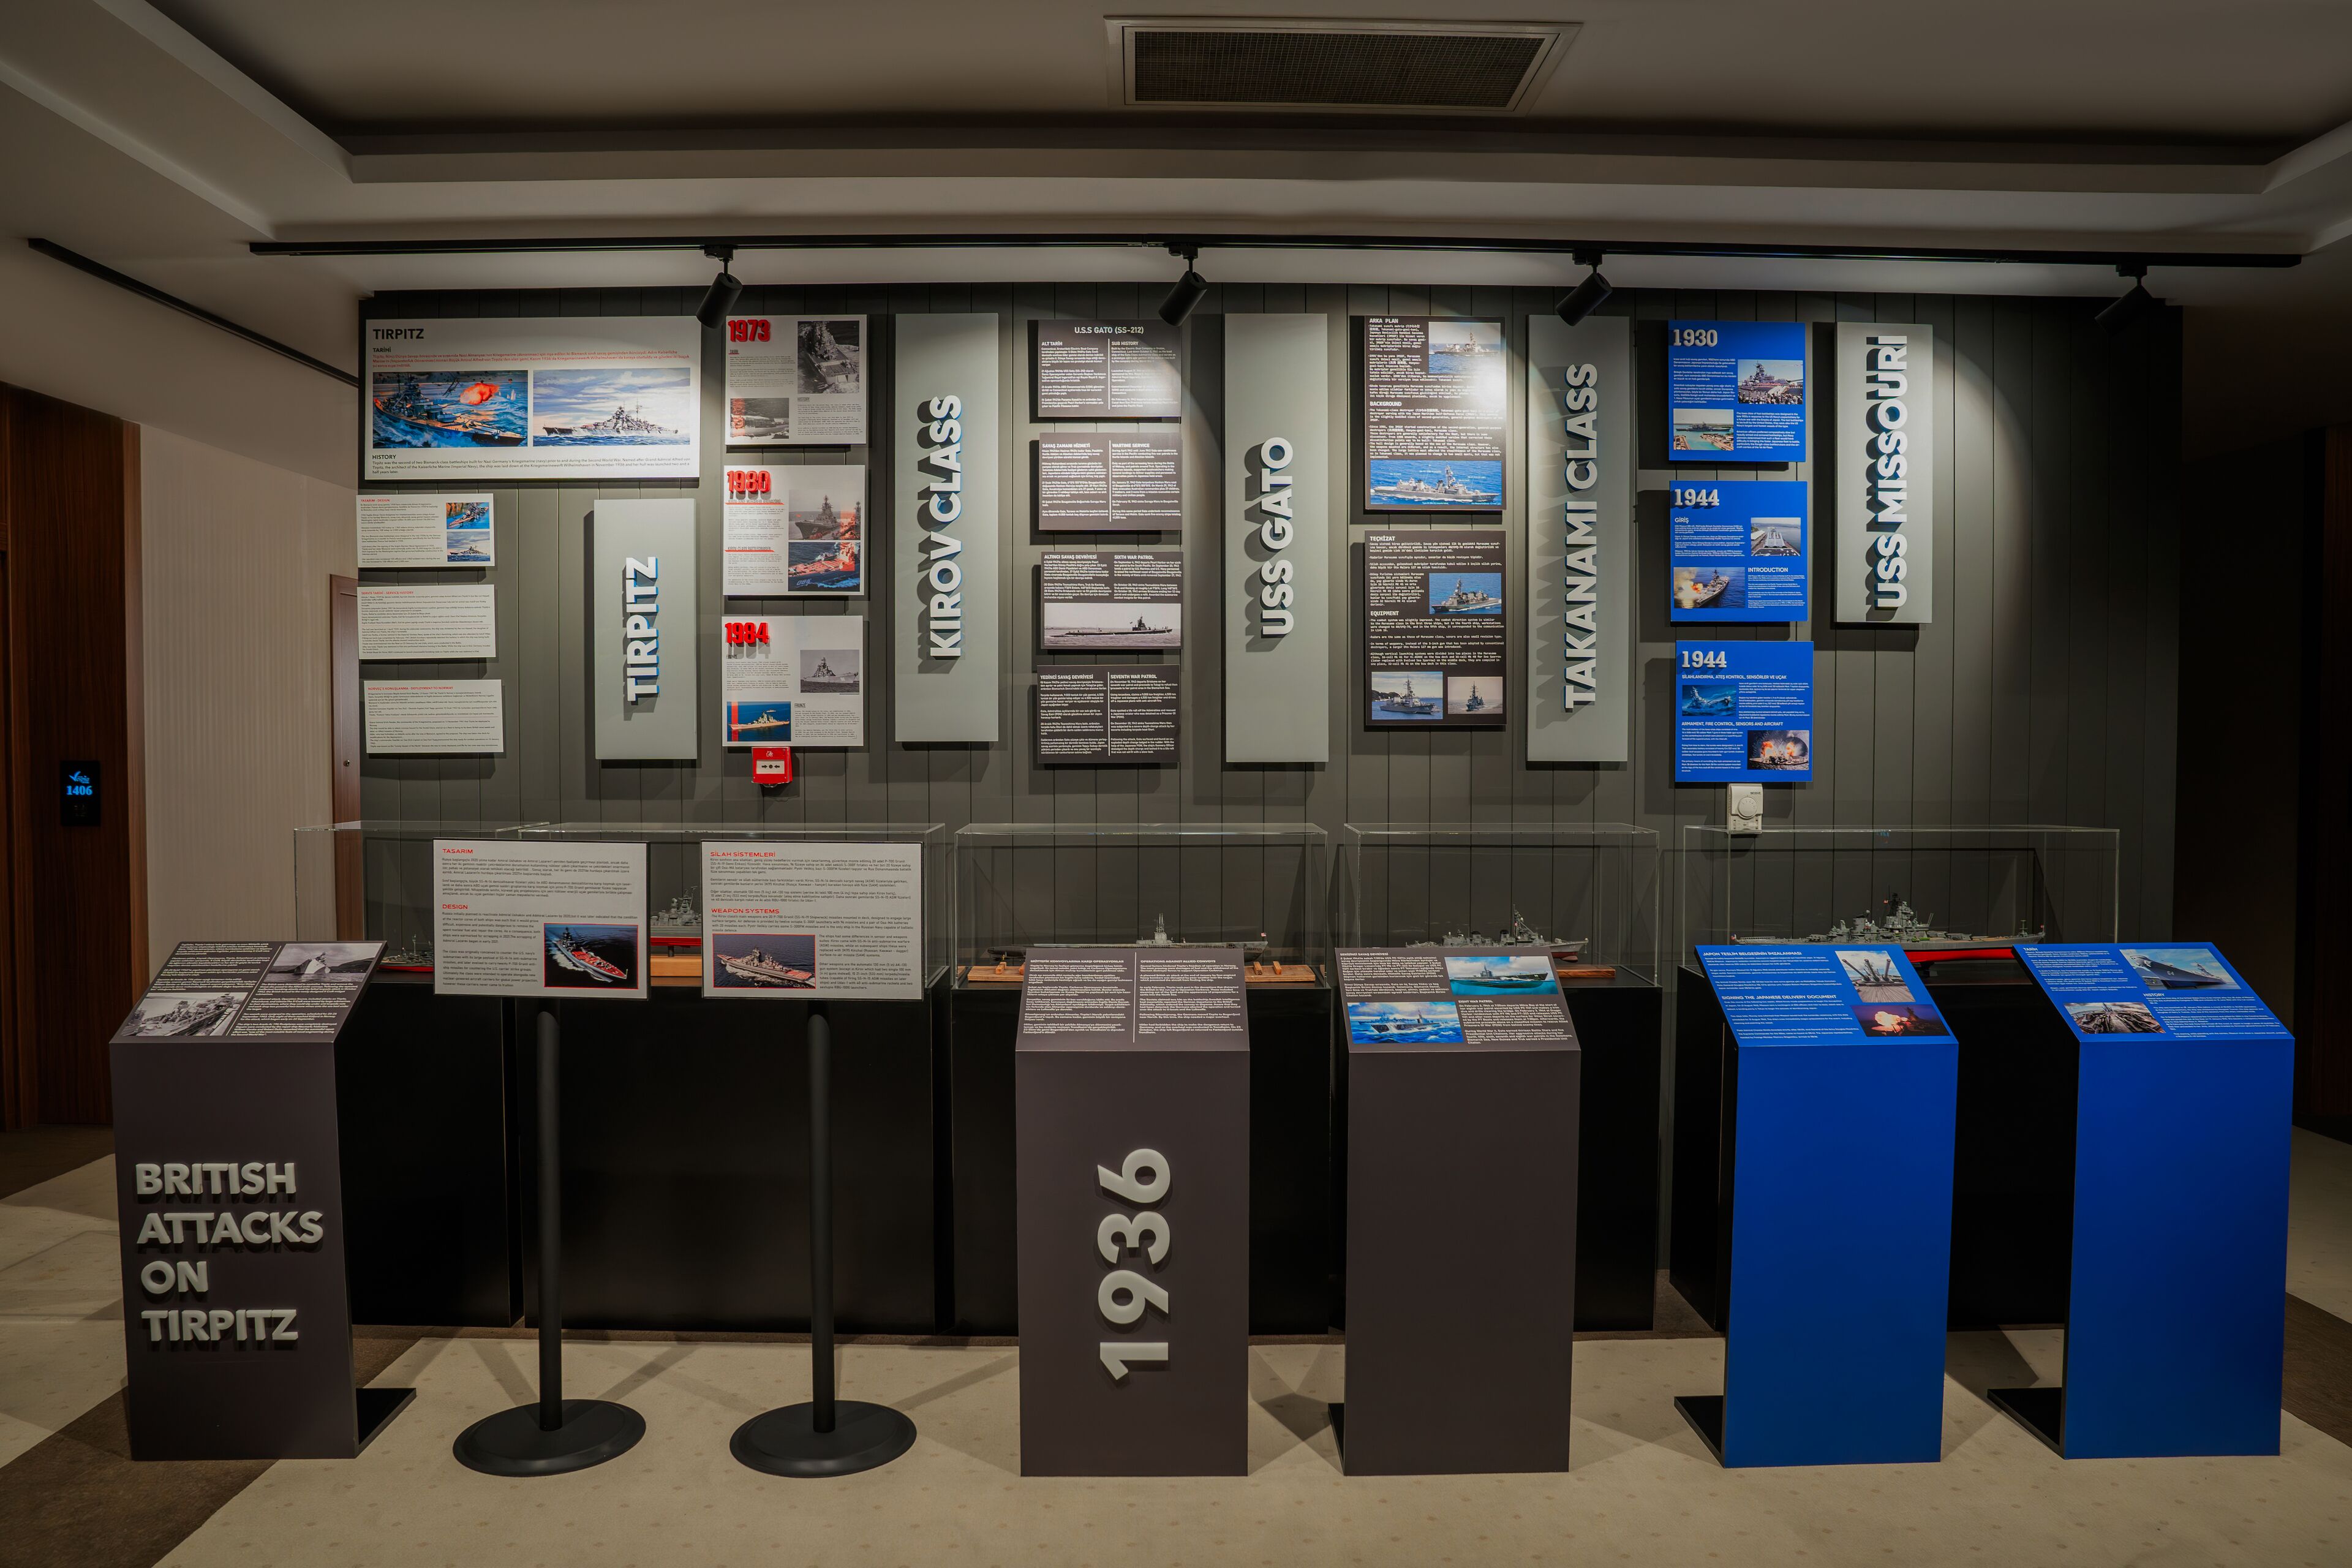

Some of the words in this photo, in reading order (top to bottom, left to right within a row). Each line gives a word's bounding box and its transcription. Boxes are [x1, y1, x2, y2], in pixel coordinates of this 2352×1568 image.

[372, 328, 424, 340] TIRPITZ
[728, 319, 770, 342] 1973
[1673, 329, 1717, 347] 1930
[1565, 363, 1597, 489] CLASS
[1877, 336, 1908, 522] MISSOURI
[929, 395, 962, 522] CLASS
[727, 470, 771, 492] 1980
[1261, 437, 1293, 549] GATO
[1675, 489, 1719, 507] 1944
[1877, 533, 1907, 607] USS
[929, 531, 962, 657] KIROV
[1261, 559, 1294, 635] USS
[1565, 502, 1597, 709] TAKANAMI
[626, 557, 658, 701] TIRPITZ
[725, 622, 769, 644] 1984
[1681, 650, 1727, 668] 1944
[66, 786, 93, 795] 1406
[136, 1163, 296, 1194] BRITISH
[137, 1211, 323, 1243] ATTACKS
[141, 1261, 208, 1294] ON
[1098, 1148, 1170, 1380] 1936
[141, 1309, 298, 1341] TIRPITZ
